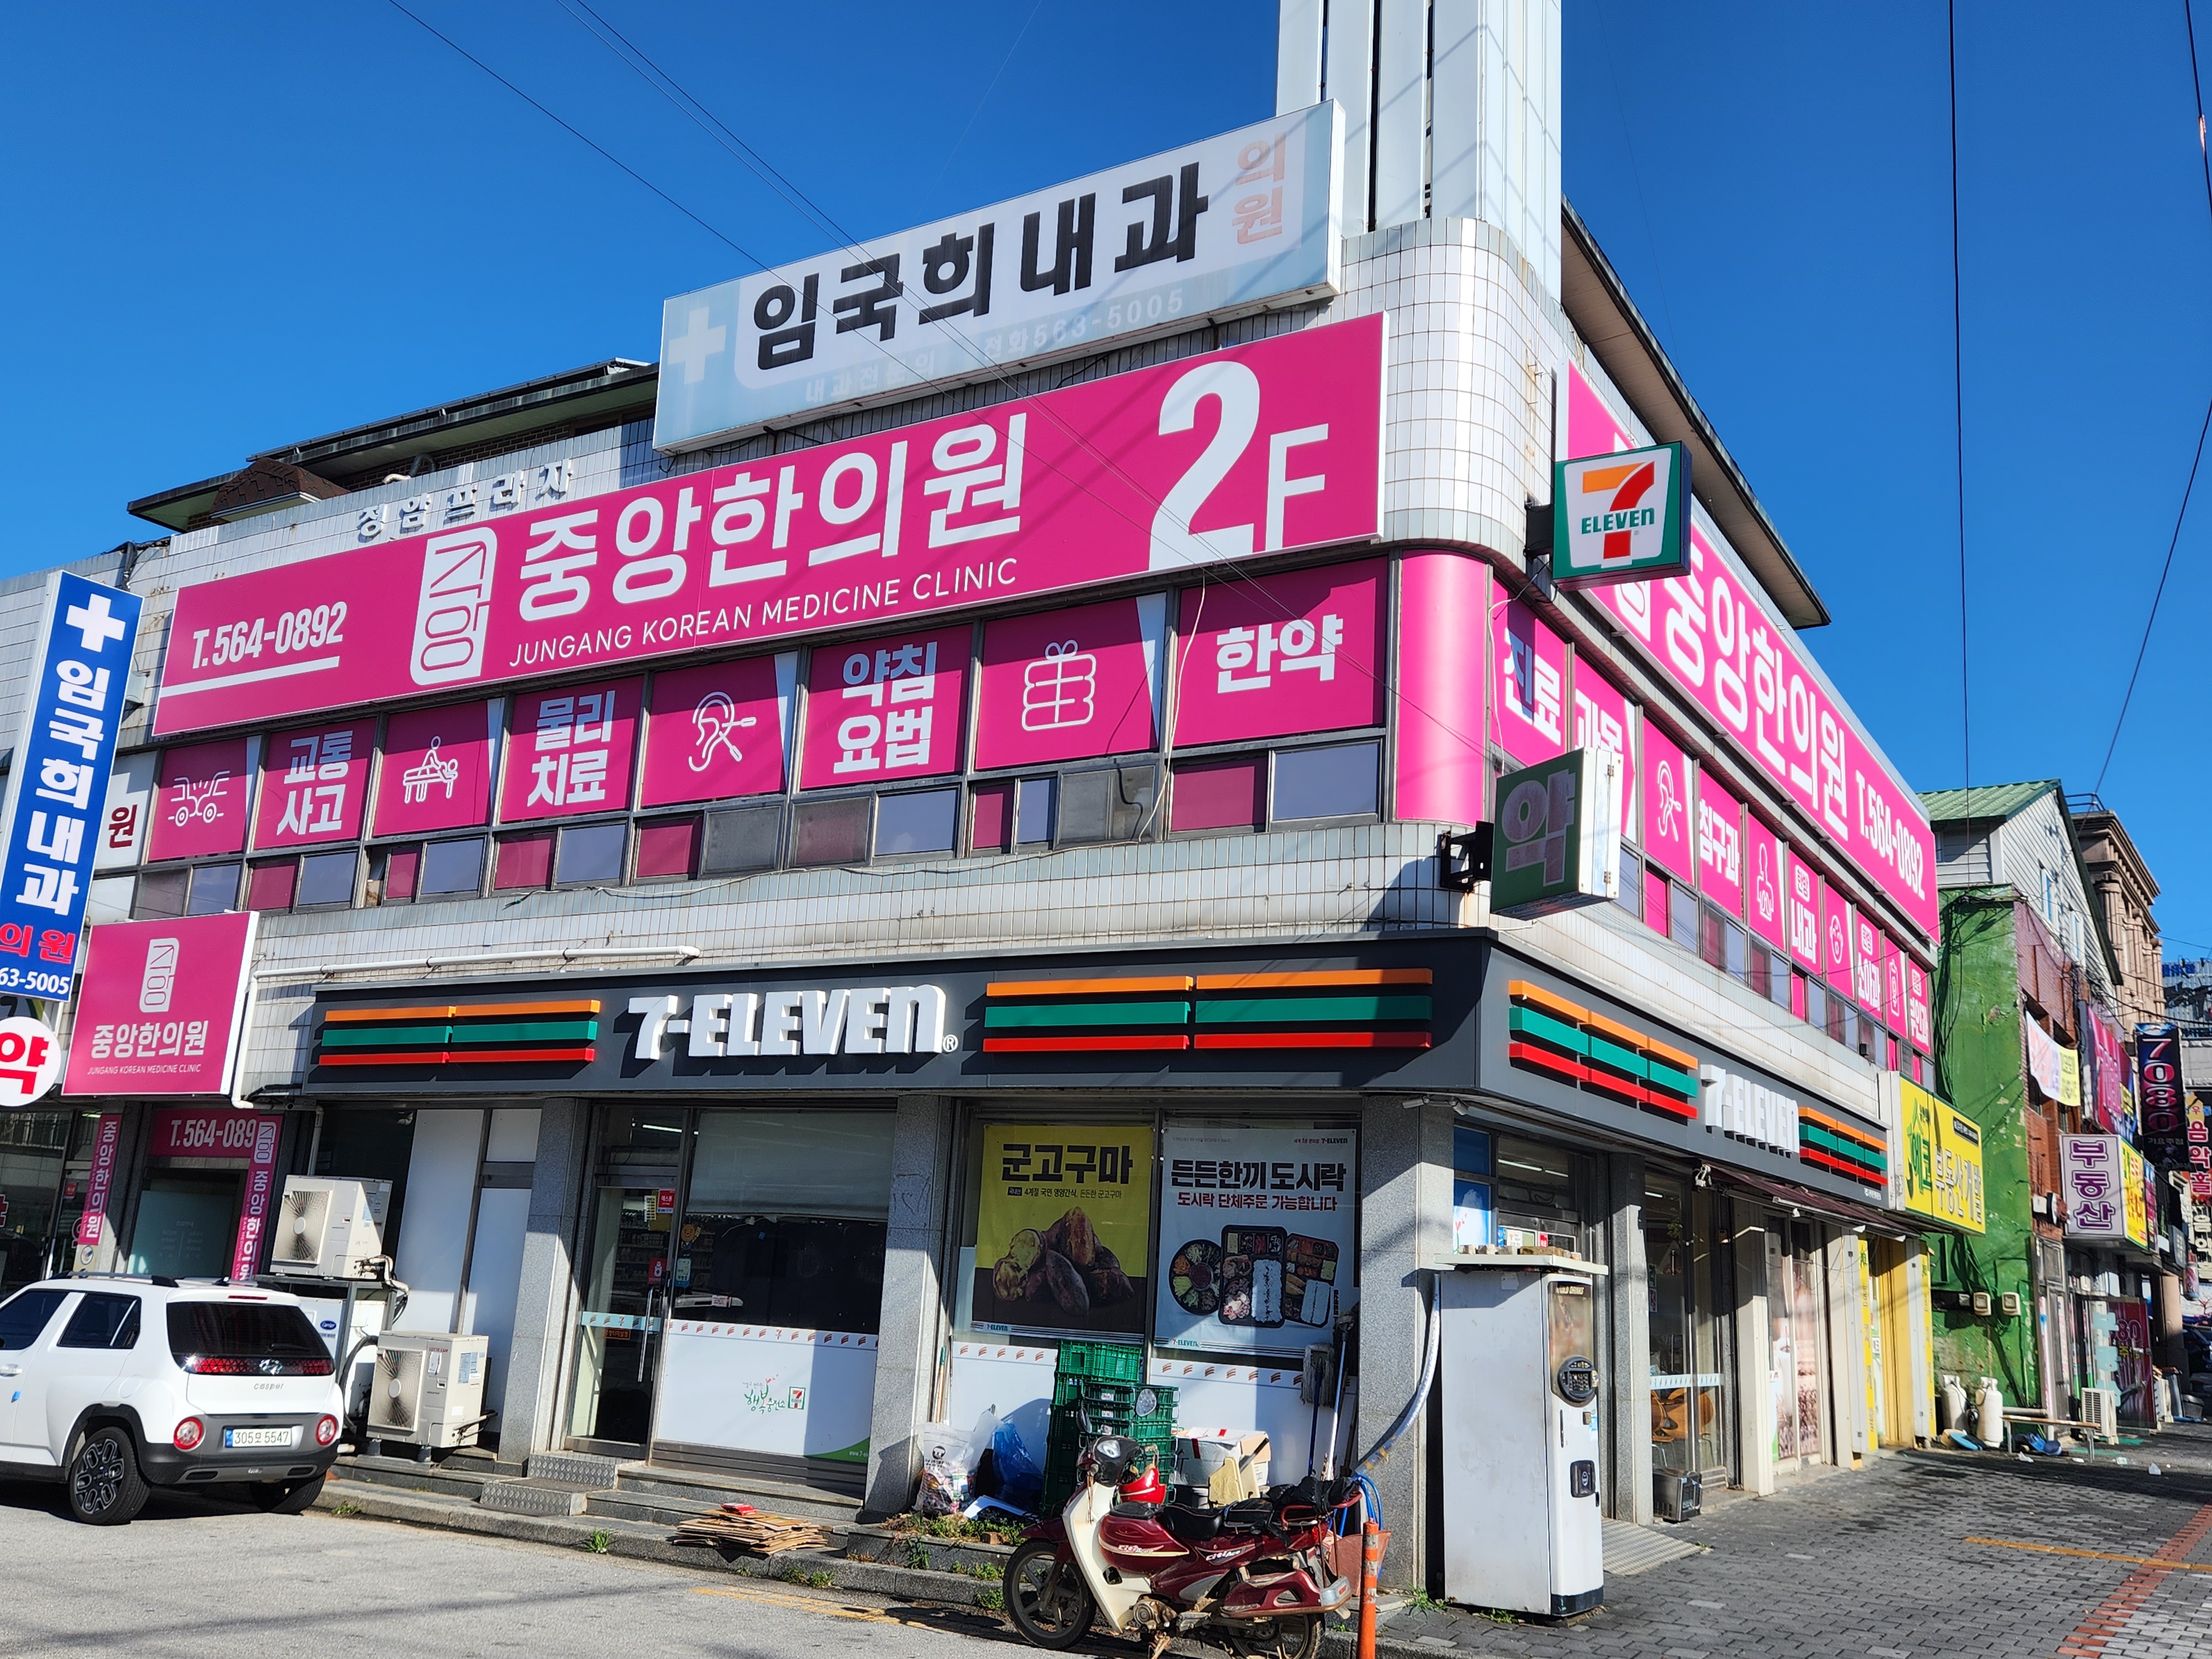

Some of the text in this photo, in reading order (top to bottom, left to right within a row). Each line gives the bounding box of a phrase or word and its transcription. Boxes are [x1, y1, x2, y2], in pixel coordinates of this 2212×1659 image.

[1232, 133, 1286, 246] 의원
[753, 161, 1209, 371] 임국희내과
[1149, 361, 1328, 571] 2F
[519, 412, 1026, 622] 중앙한의원
[192, 601, 347, 669] T.564-0892
[509, 557, 1018, 667] JUNGANG KOREAN MEDICINE CLINIC
[843, 642, 937, 707] 약침
[1217, 614, 1343, 693] 한약
[535, 691, 614, 751] 물리
[833, 707, 932, 774] 요법
[1665, 540, 1925, 900] 중앙한의원 T.564-0892
[15, 659, 111, 916] 임국희내과
[283, 730, 353, 784] 교통
[527, 749, 608, 806] 치료
[108, 805, 137, 848] 원
[277, 785, 343, 836] 사고
[1502, 769, 1576, 886] 약
[1699, 798, 1739, 886] 침구과
[0, 922, 76, 964] 의원
[1791, 899, 1817, 964] 내과
[1858, 952, 1881, 1011] 소아과
[0, 1032, 50, 1094] 약
[87, 1064, 201, 1075] JUNGANG KOREAN MEDICINE CLINIC
[91, 1021, 208, 1059] 중앙한의원
[2142, 1038, 2179, 1132] 7080
[170, 1119, 257, 1147] T.564-089
[1002, 1144, 1133, 1184] 군고구마
[86, 1121, 117, 1238] 중앙한의원
[1098, 1190, 1122, 1199] 군고구마
[1171, 1160, 1347, 1192] 든든한끼 도시락
[1177, 1192, 1338, 1212] 도시락 단체주문 가능합니다
[1936, 1144, 1983, 1224] 부동산개발
[2070, 1141, 2115, 1229] 부동산
[744, 1385, 785, 1415] 행복충전소
[264, 1431, 289, 1443] 5547
